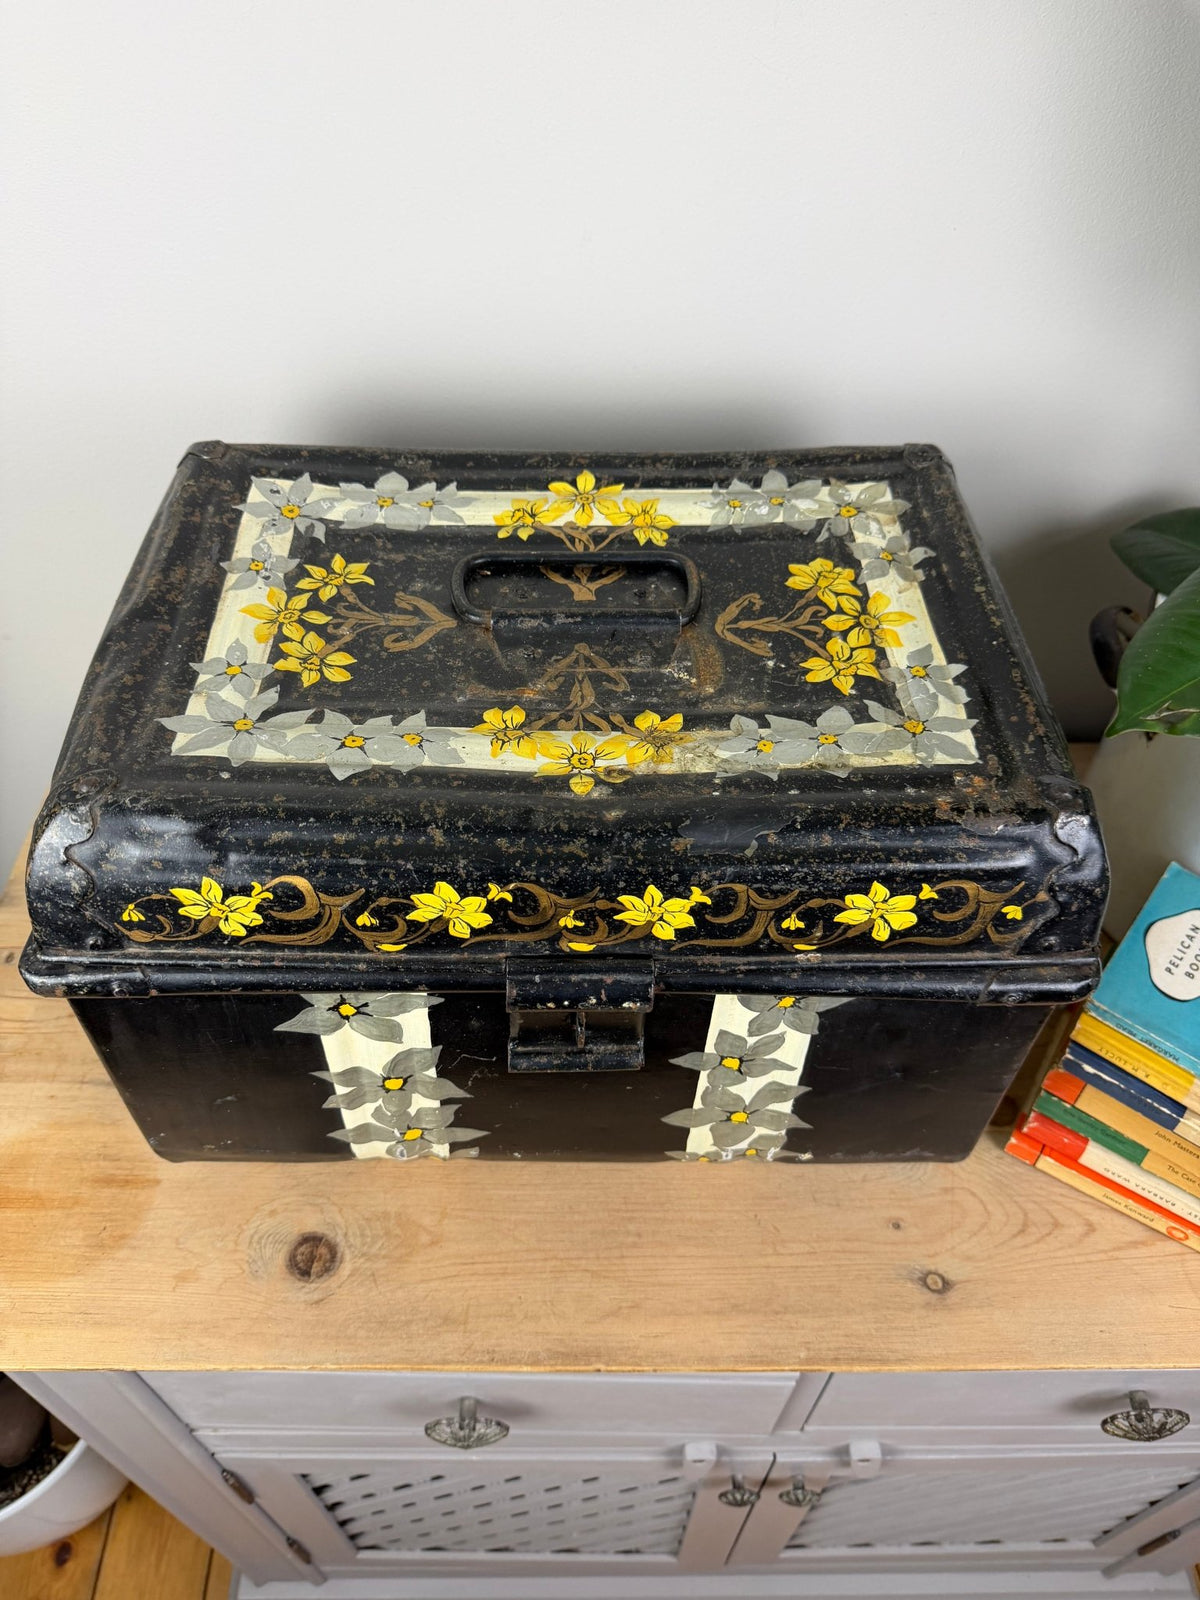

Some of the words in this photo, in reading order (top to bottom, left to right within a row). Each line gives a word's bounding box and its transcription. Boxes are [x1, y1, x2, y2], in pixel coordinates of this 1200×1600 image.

[1164, 924, 1200, 976] PELICAN
[1154, 1130, 1171, 1144] John
[1173, 1140, 1200, 1160] Masters
[1104, 1167, 1131, 1183] WARD
[1167, 1165, 1179, 1175] The
[1181, 1173, 1197, 1184] Case
[1102, 1192, 1122, 1206] James
[1134, 1184, 1177, 1207] BARBARA
